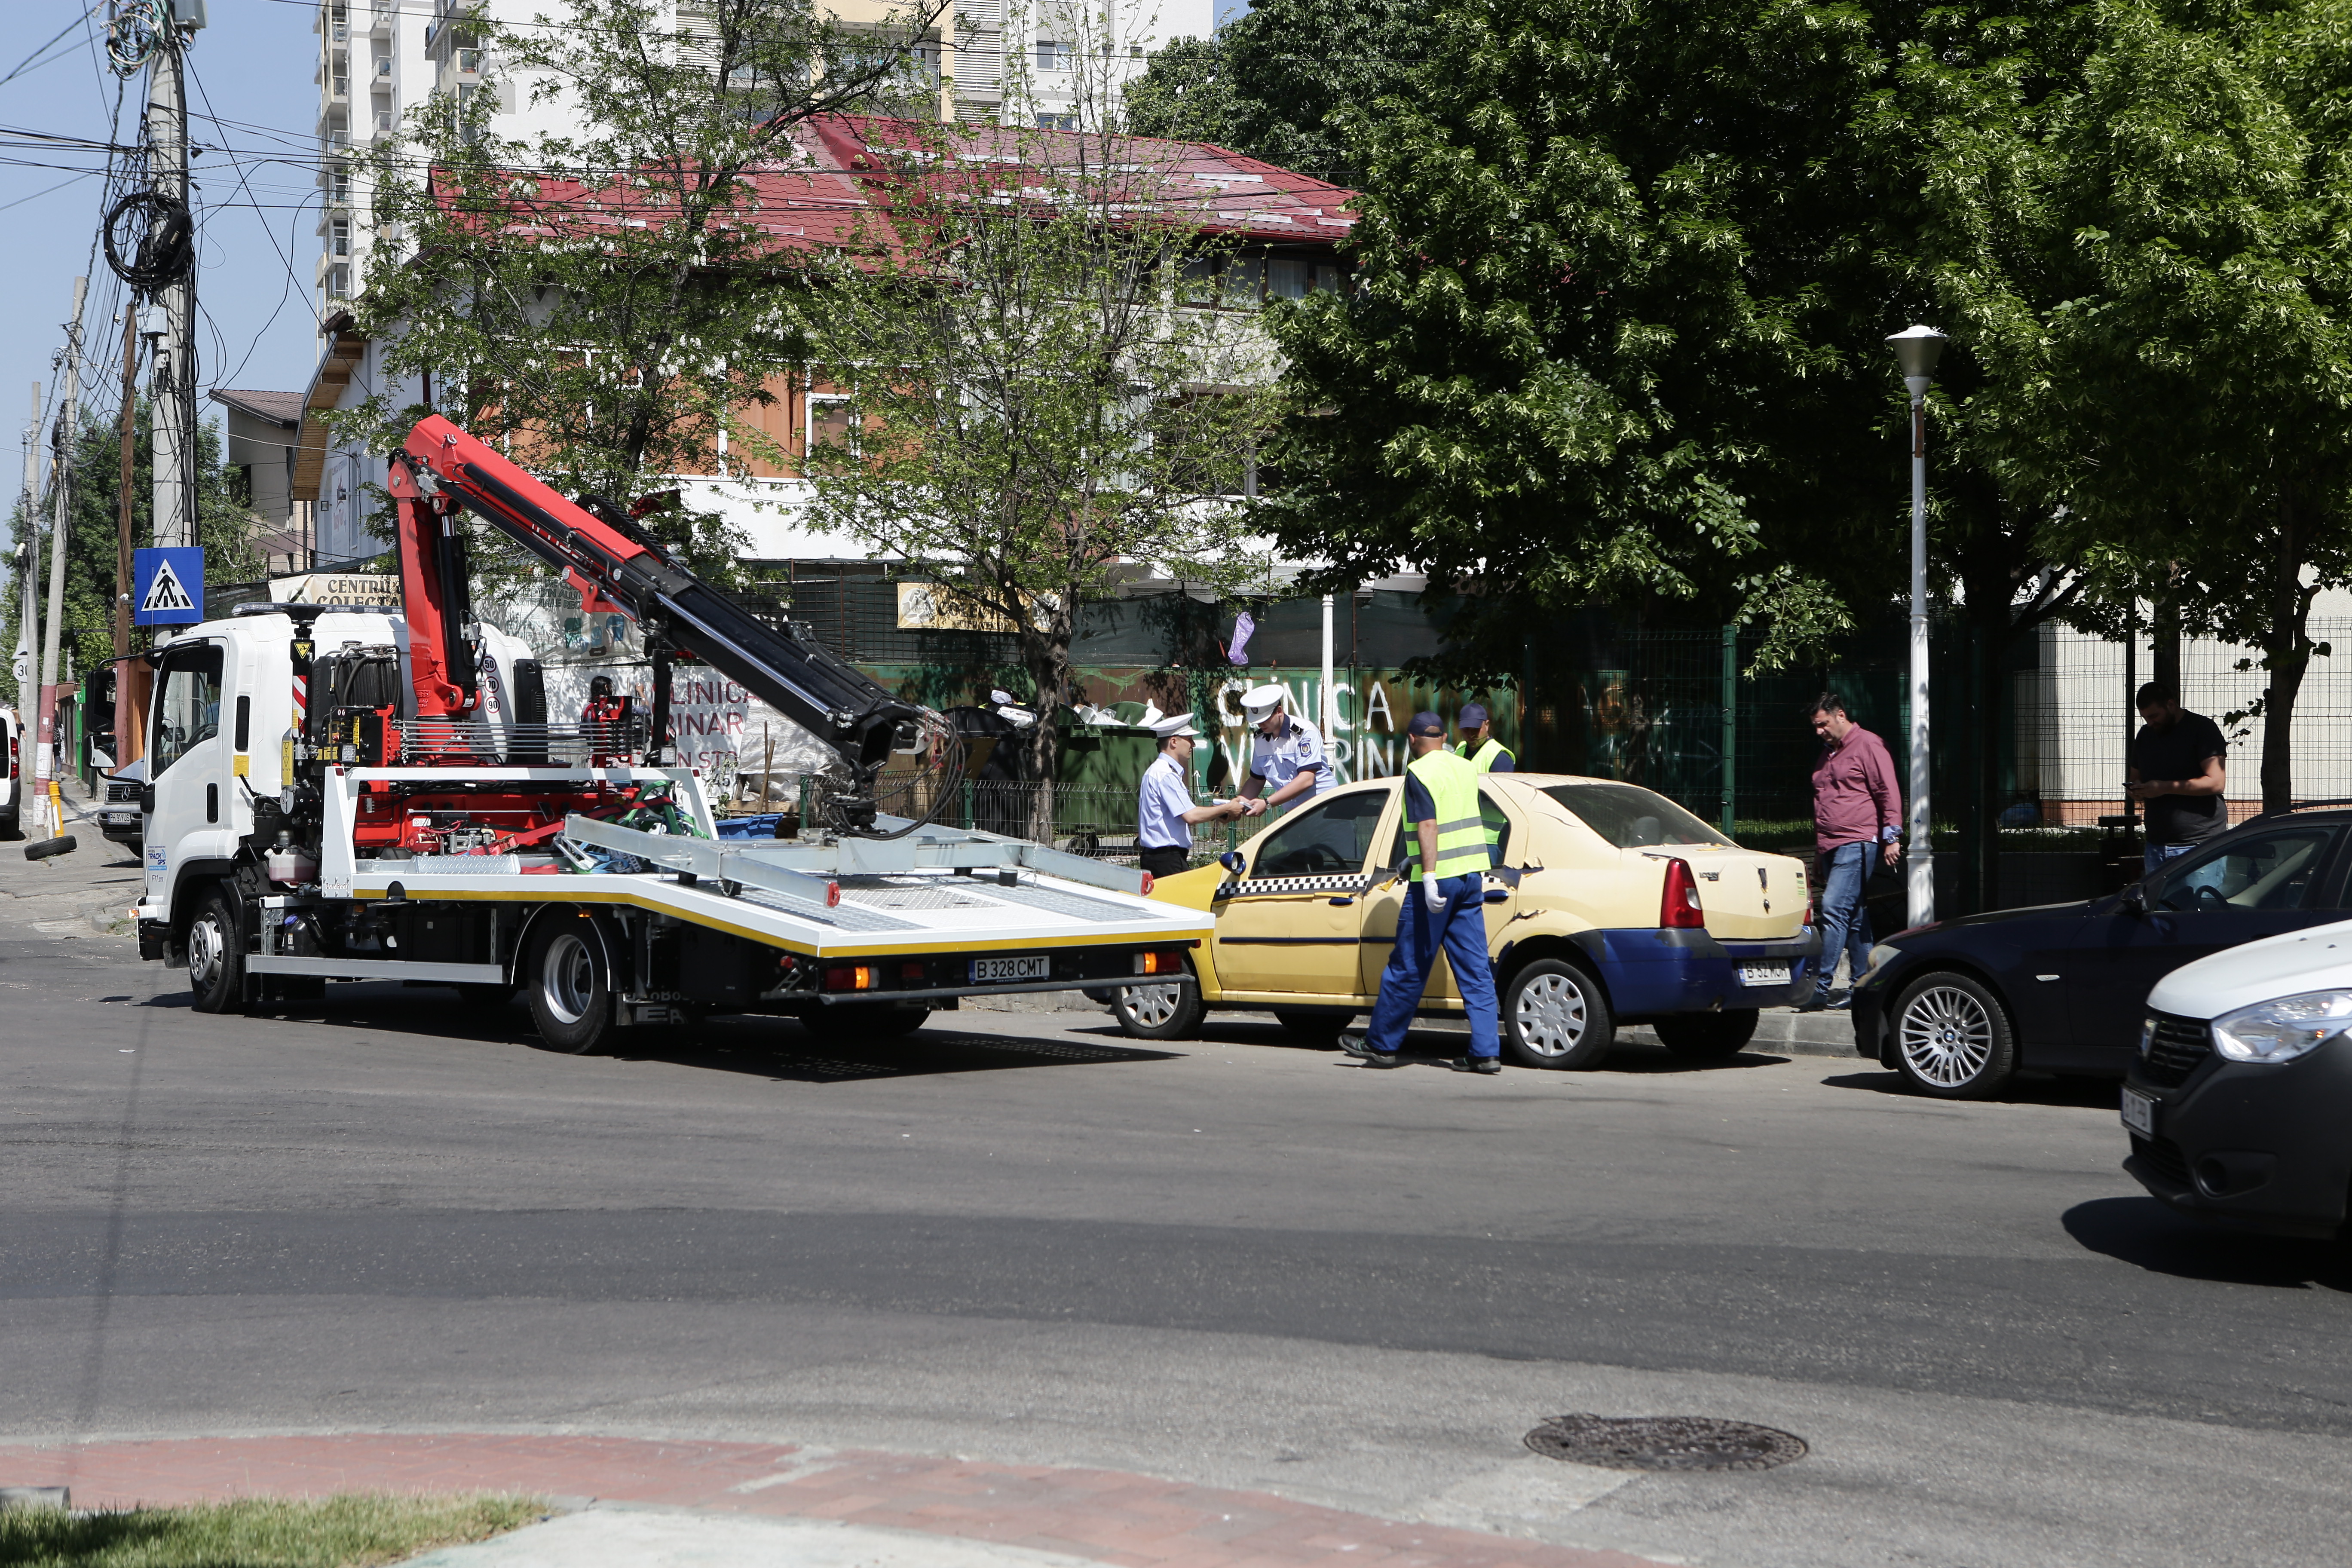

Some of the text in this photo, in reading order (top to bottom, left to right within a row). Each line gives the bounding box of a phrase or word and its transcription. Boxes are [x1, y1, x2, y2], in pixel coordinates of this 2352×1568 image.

[485, 660, 494, 668] 50
[488, 680, 496, 689] 70
[670, 681, 761, 705] LINICA
[488, 701, 498, 709] 90
[1217, 677, 1394, 733] CNICA
[977, 958, 1044, 979] B 328 CMT
[1746, 963, 1754, 978] B
[1756, 962, 1769, 978] 52
